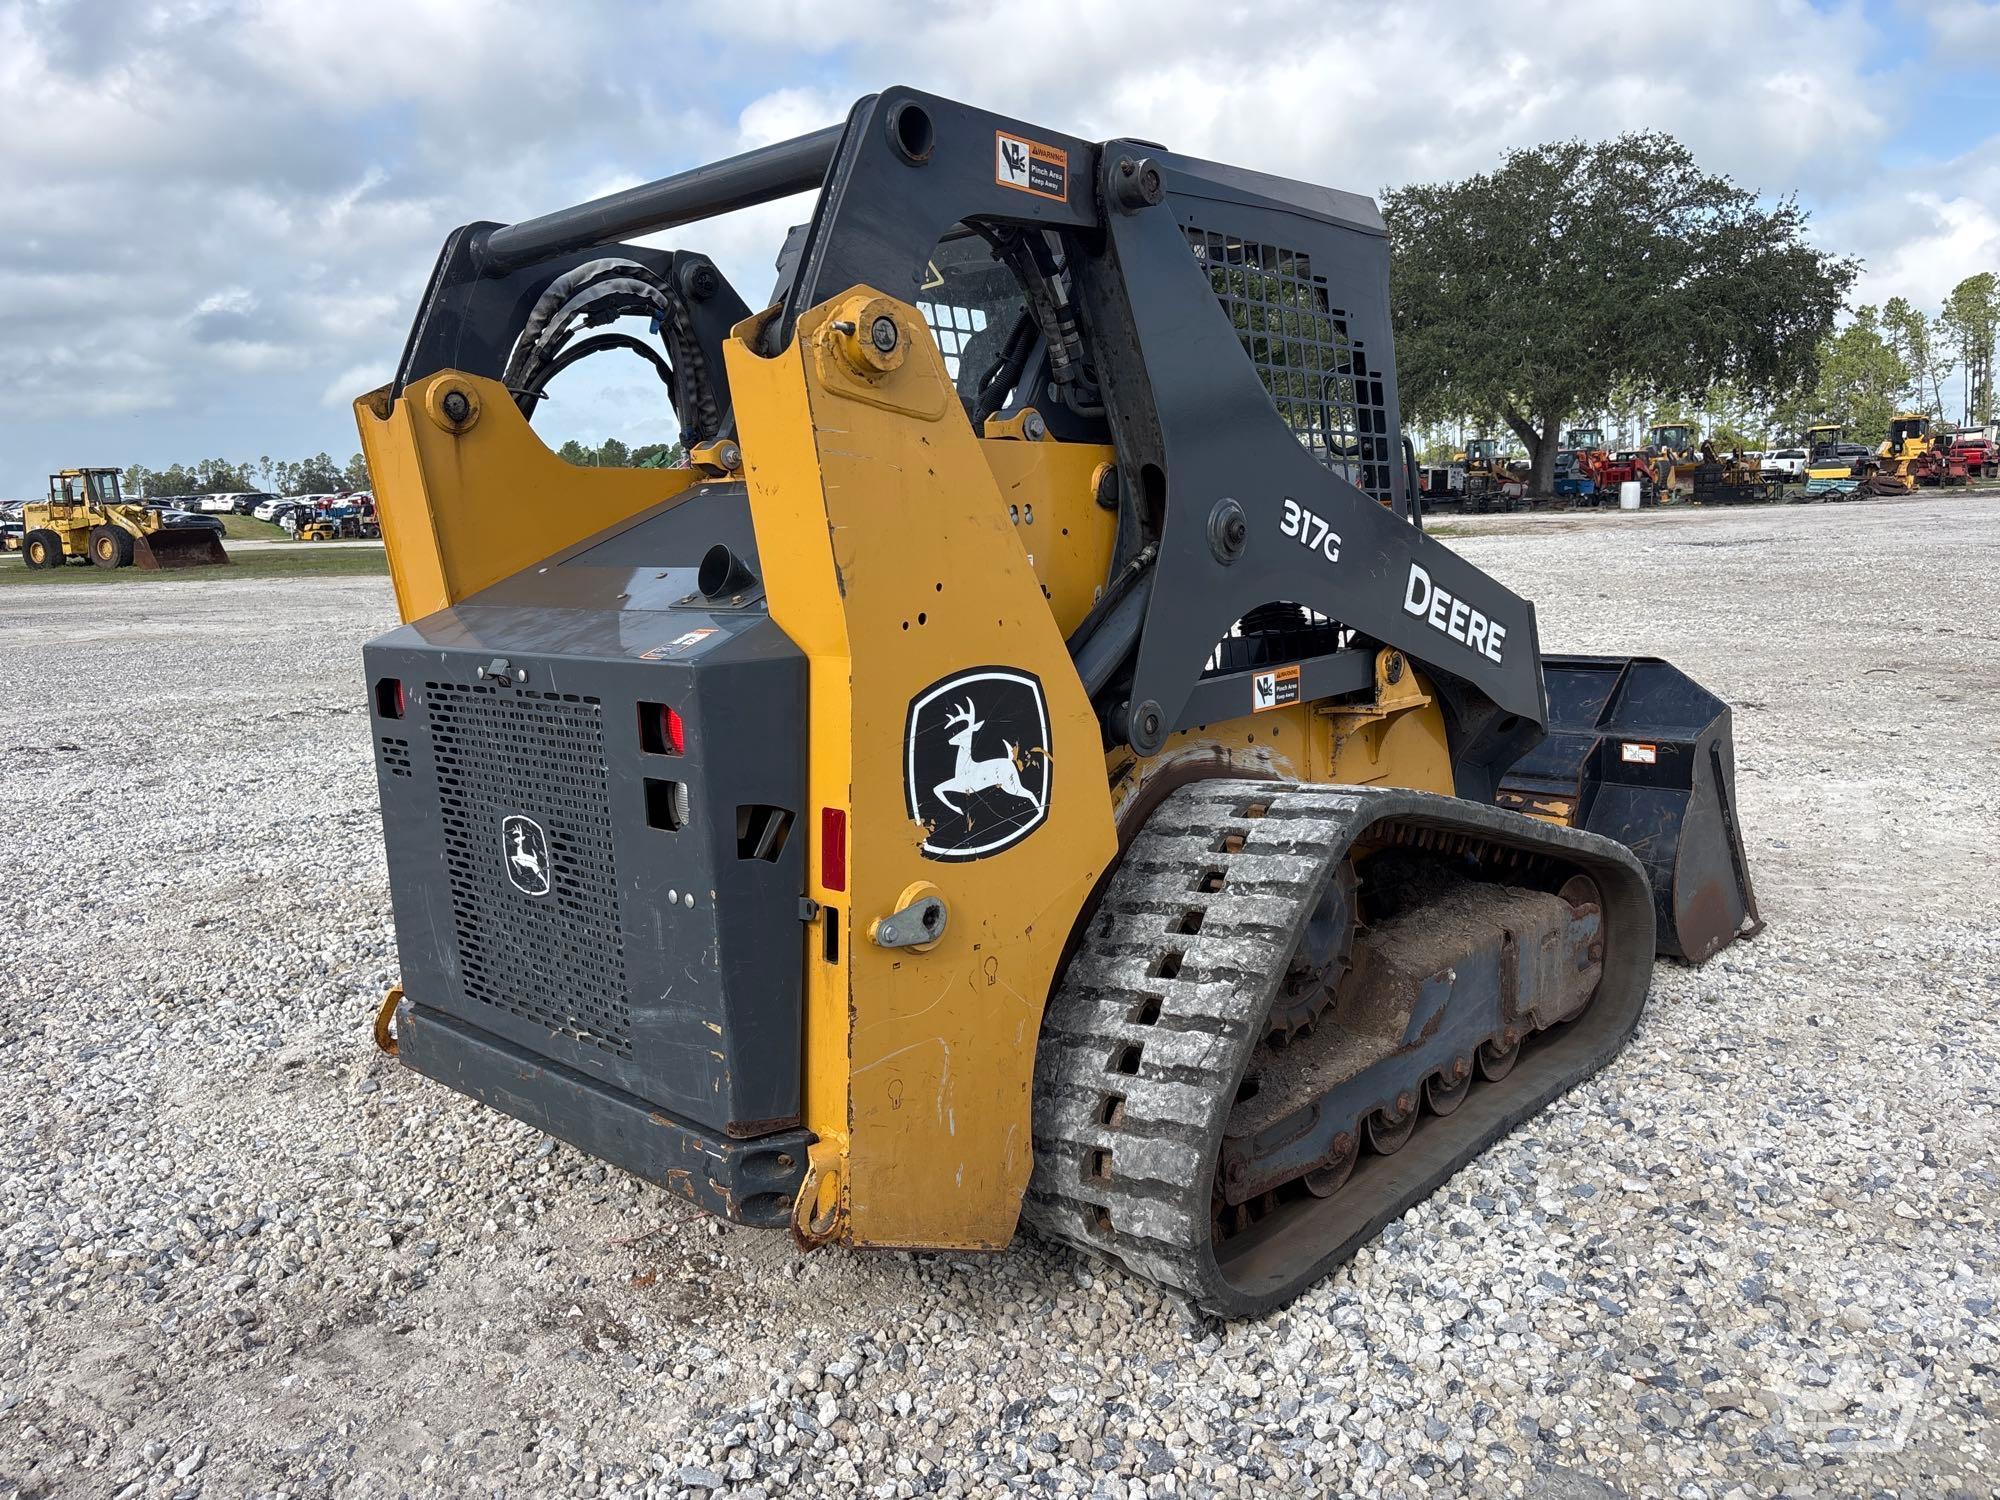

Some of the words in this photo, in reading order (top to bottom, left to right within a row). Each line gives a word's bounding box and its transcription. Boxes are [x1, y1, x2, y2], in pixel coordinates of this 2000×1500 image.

[1037, 148, 1064, 162] WARNING
[1031, 164, 1048, 177] Pinch
[1049, 170, 1063, 181] Area
[1031, 176, 1044, 187] Keep
[1044, 180, 1059, 190] Away
[1280, 499, 1342, 563] 317G
[1403, 562, 1507, 664] DEERE
